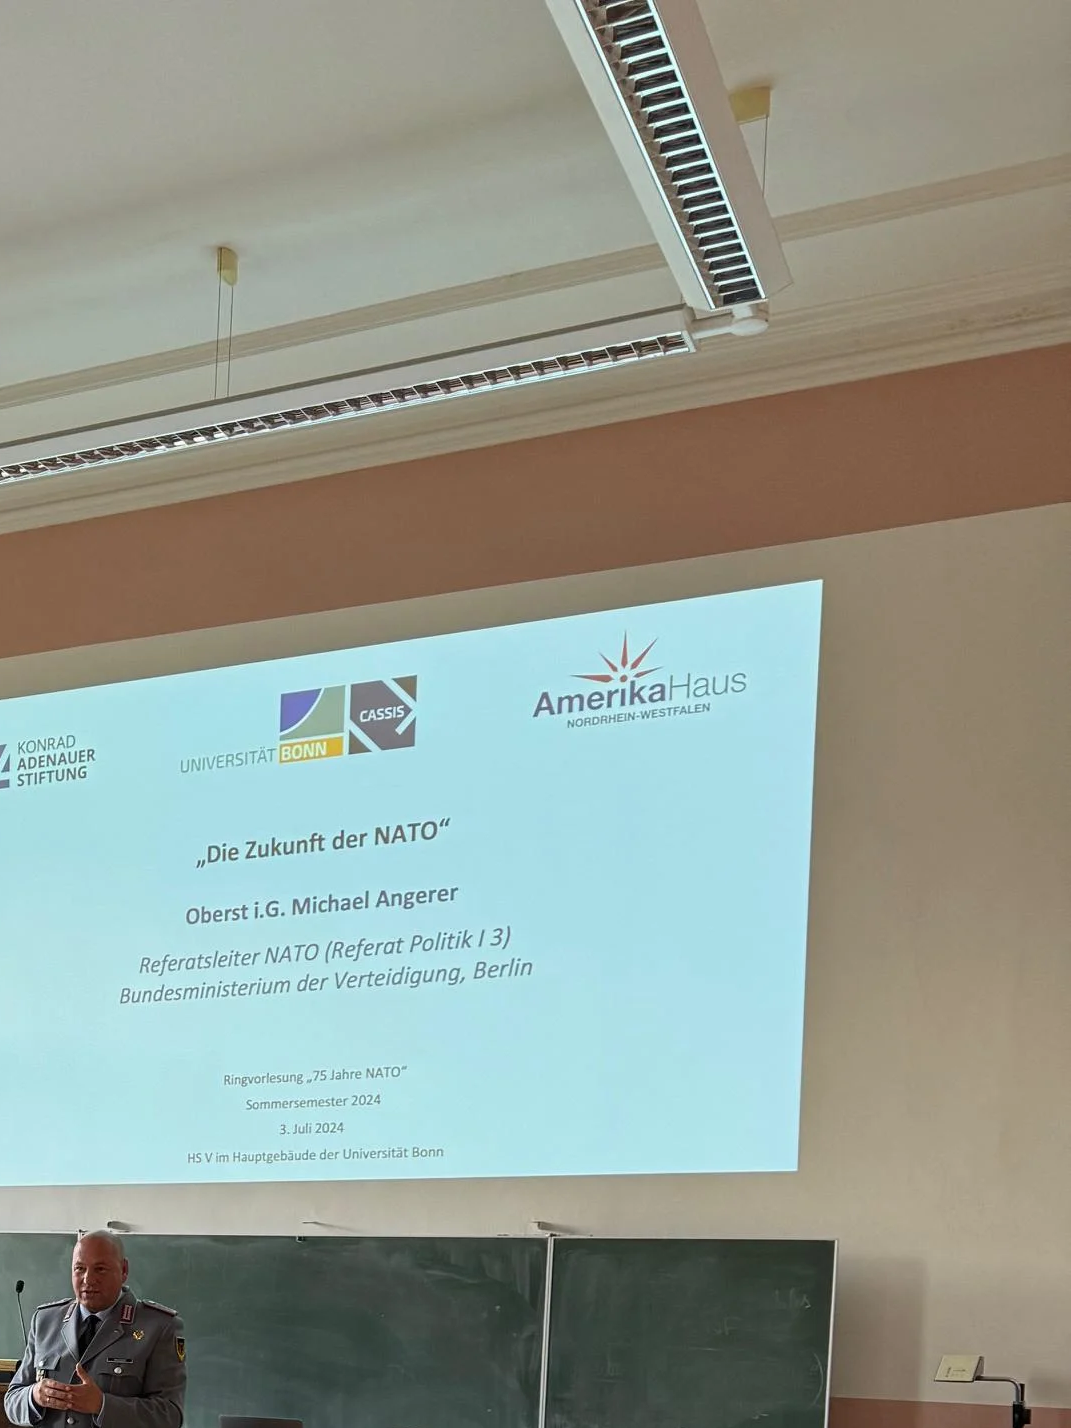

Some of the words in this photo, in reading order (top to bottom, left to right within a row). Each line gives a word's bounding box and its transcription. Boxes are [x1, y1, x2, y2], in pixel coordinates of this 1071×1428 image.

[532, 672, 747, 718] AmerikaHaus
[359, 705, 405, 723] CASSIS
[567, 702, 711, 729] NORDRHEIN-WESTFALEN
[17, 734, 76, 755] KONRAD
[17, 748, 96, 771] ADENAUER
[180, 746, 276, 773] UNIVERSITÄT
[281, 741, 327, 762] BONN
[17, 765, 88, 787] STIFTUNG
[196, 842, 239, 868] „Die
[245, 832, 325, 860] Zukunft
[332, 829, 368, 850] der
[375, 817, 451, 846] NATO“
[186, 903, 249, 925] Oberst
[254, 900, 285, 919] i.G.
[292, 890, 370, 916] Michael
[376, 885, 459, 910] Angerer
[139, 950, 261, 977] Referatsleiter
[264, 943, 319, 965] NATO
[325, 936, 404, 964] (Referat
[409, 929, 473, 953] Politik
[490, 925, 511, 950] 3)
[120, 977, 291, 1005] Bundesministerium
[296, 974, 329, 992] der
[334, 966, 466, 989] Verteidigung,
[473, 957, 533, 980] Berlin
[223, 1072, 304, 1088] Ringvorlesung
[306, 1069, 327, 1084] „75
[330, 1068, 362, 1081] Jahre
[365, 1065, 408, 1079] NATO“
[245, 1097, 348, 1111] Sommersemester
[350, 1094, 382, 1107] 2024
[279, 1124, 291, 1135] 3.
[292, 1123, 313, 1135] Juli
[315, 1122, 345, 1134] 2024
[187, 1153, 203, 1164] HS
[204, 1153, 214, 1163] V
[215, 1152, 230, 1163] im
[232, 1149, 317, 1165] Hauptgebäude
[319, 1149, 340, 1161] der
[342, 1146, 409, 1160] Universität
[411, 1146, 445, 1158] Bonn
